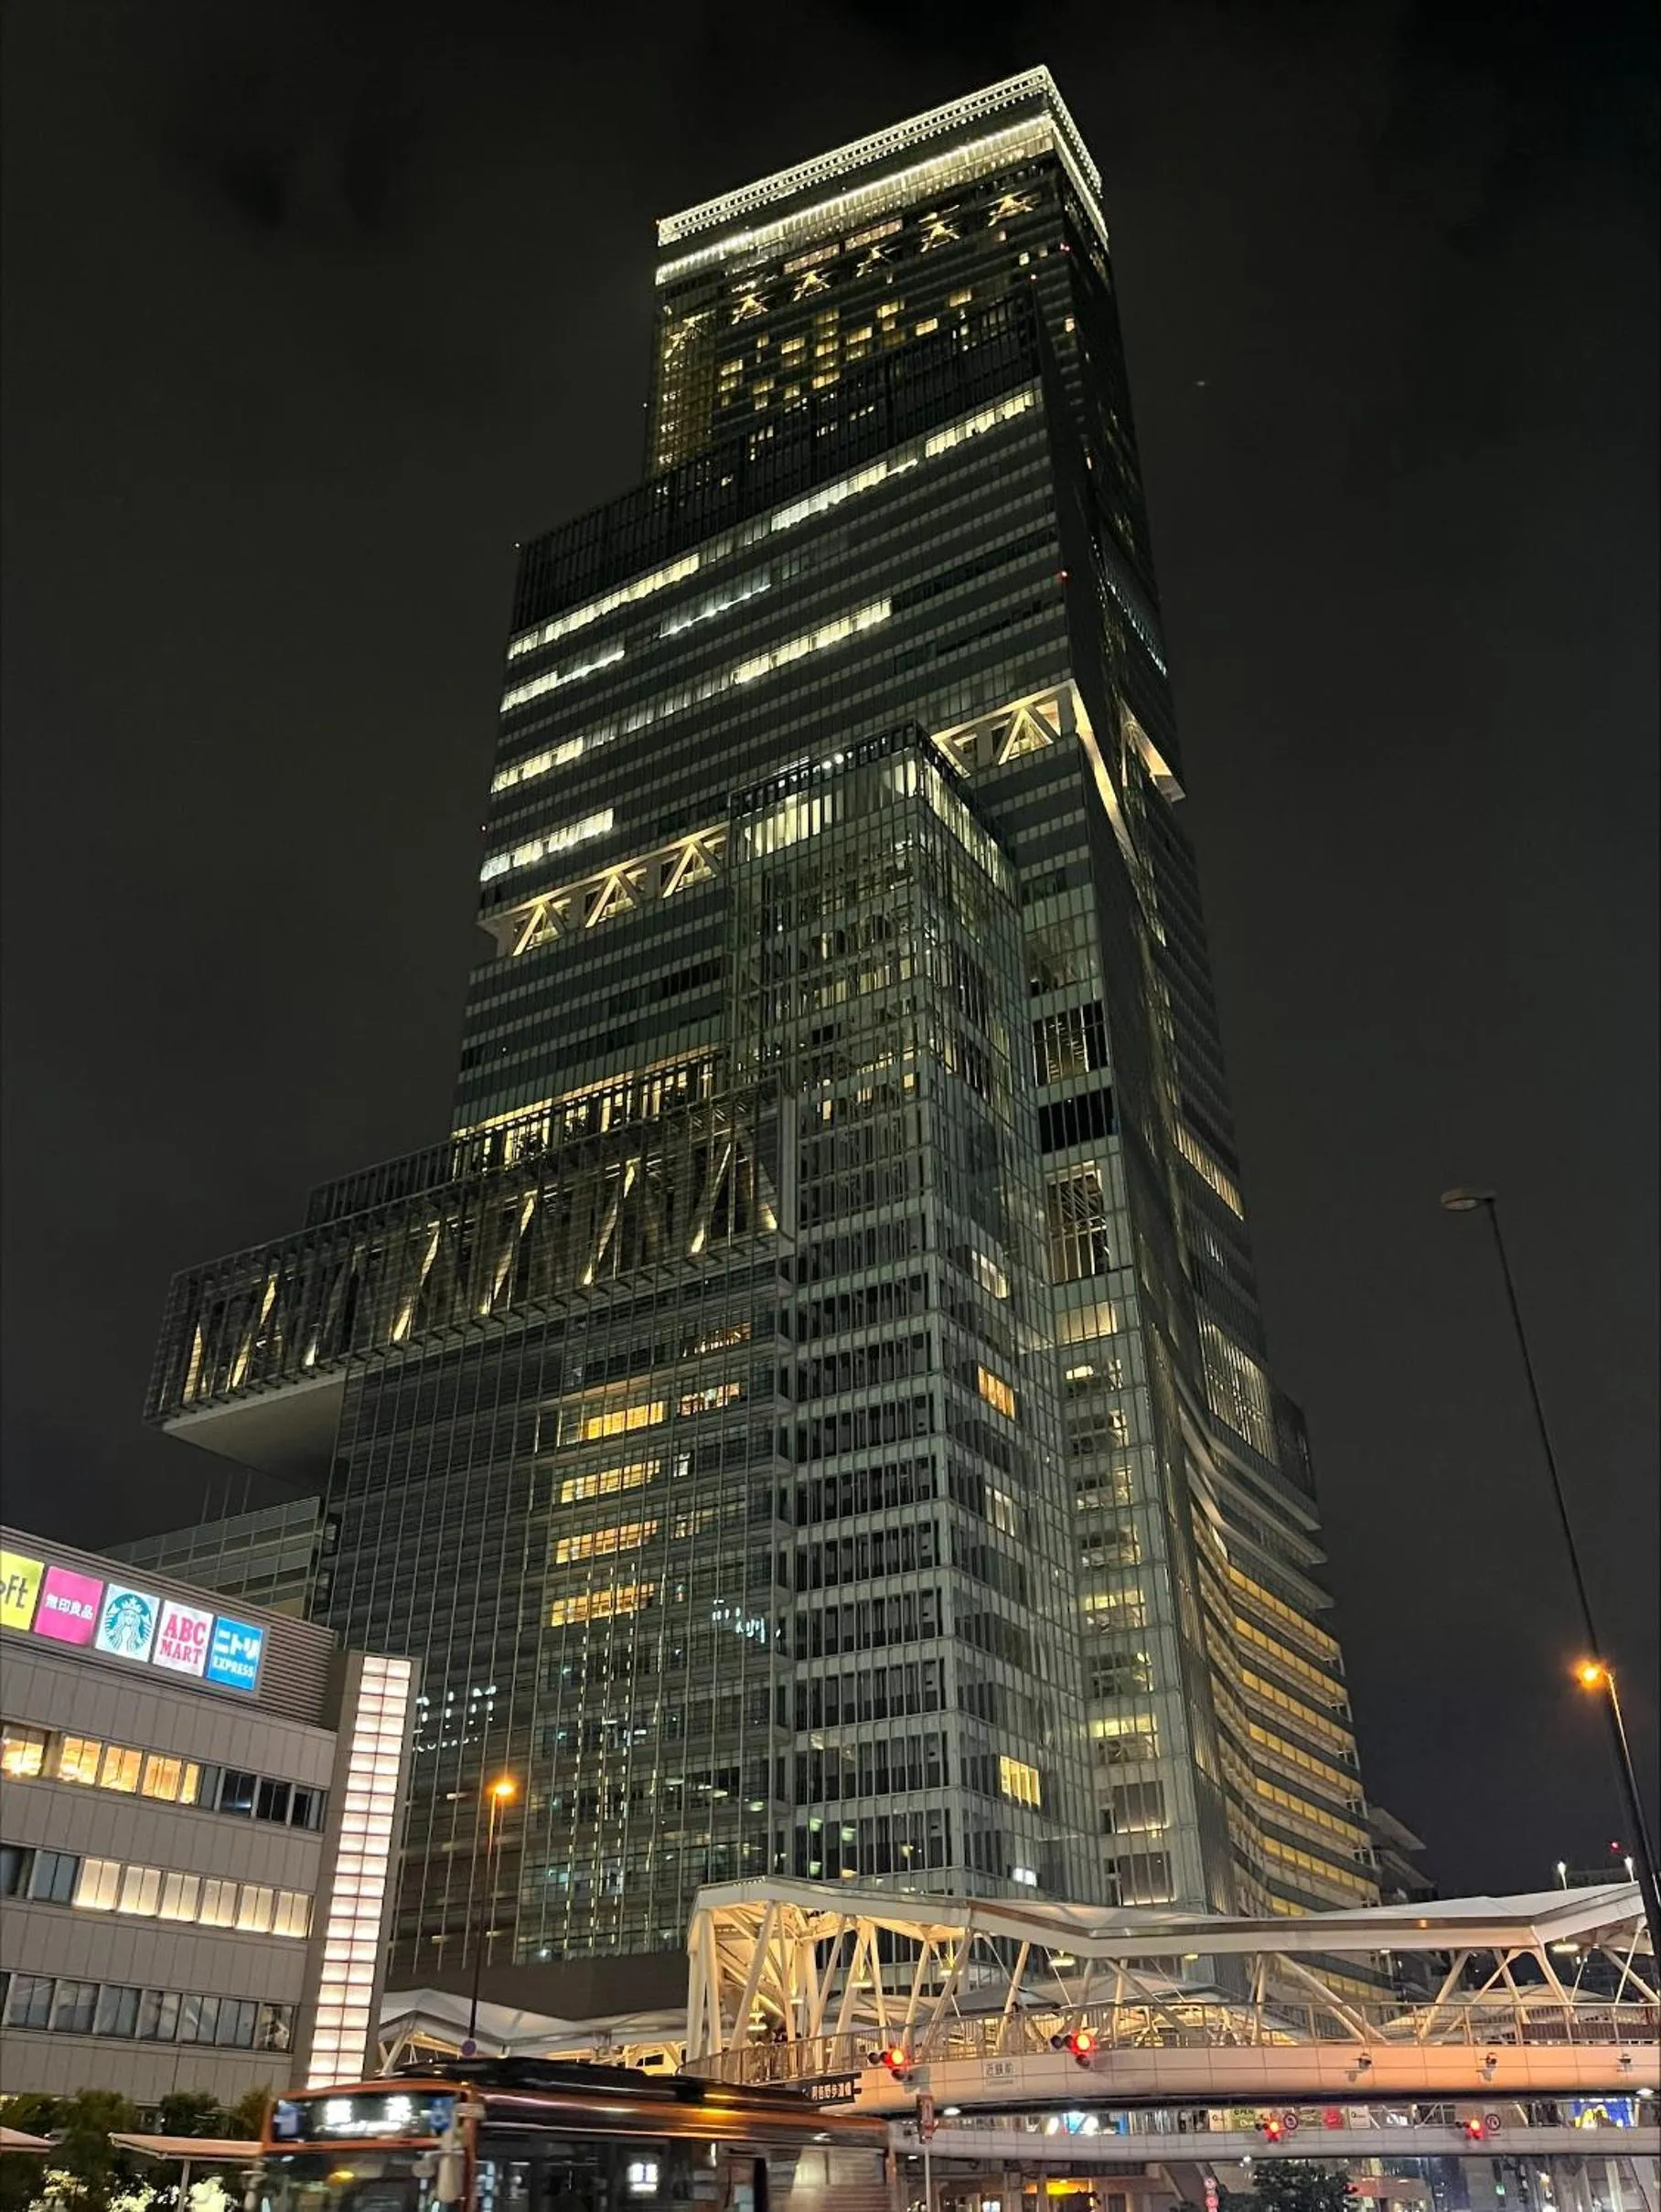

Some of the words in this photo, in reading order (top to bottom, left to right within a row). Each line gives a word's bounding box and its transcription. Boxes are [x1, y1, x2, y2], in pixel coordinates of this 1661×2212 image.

[45, 1594, 93, 1620] 無印良品
[164, 1613, 207, 1646] ABC
[160, 1639, 202, 1664] MART
[214, 1630, 259, 1661] ニトリ
[212, 1655, 254, 1678] EXPRESS
